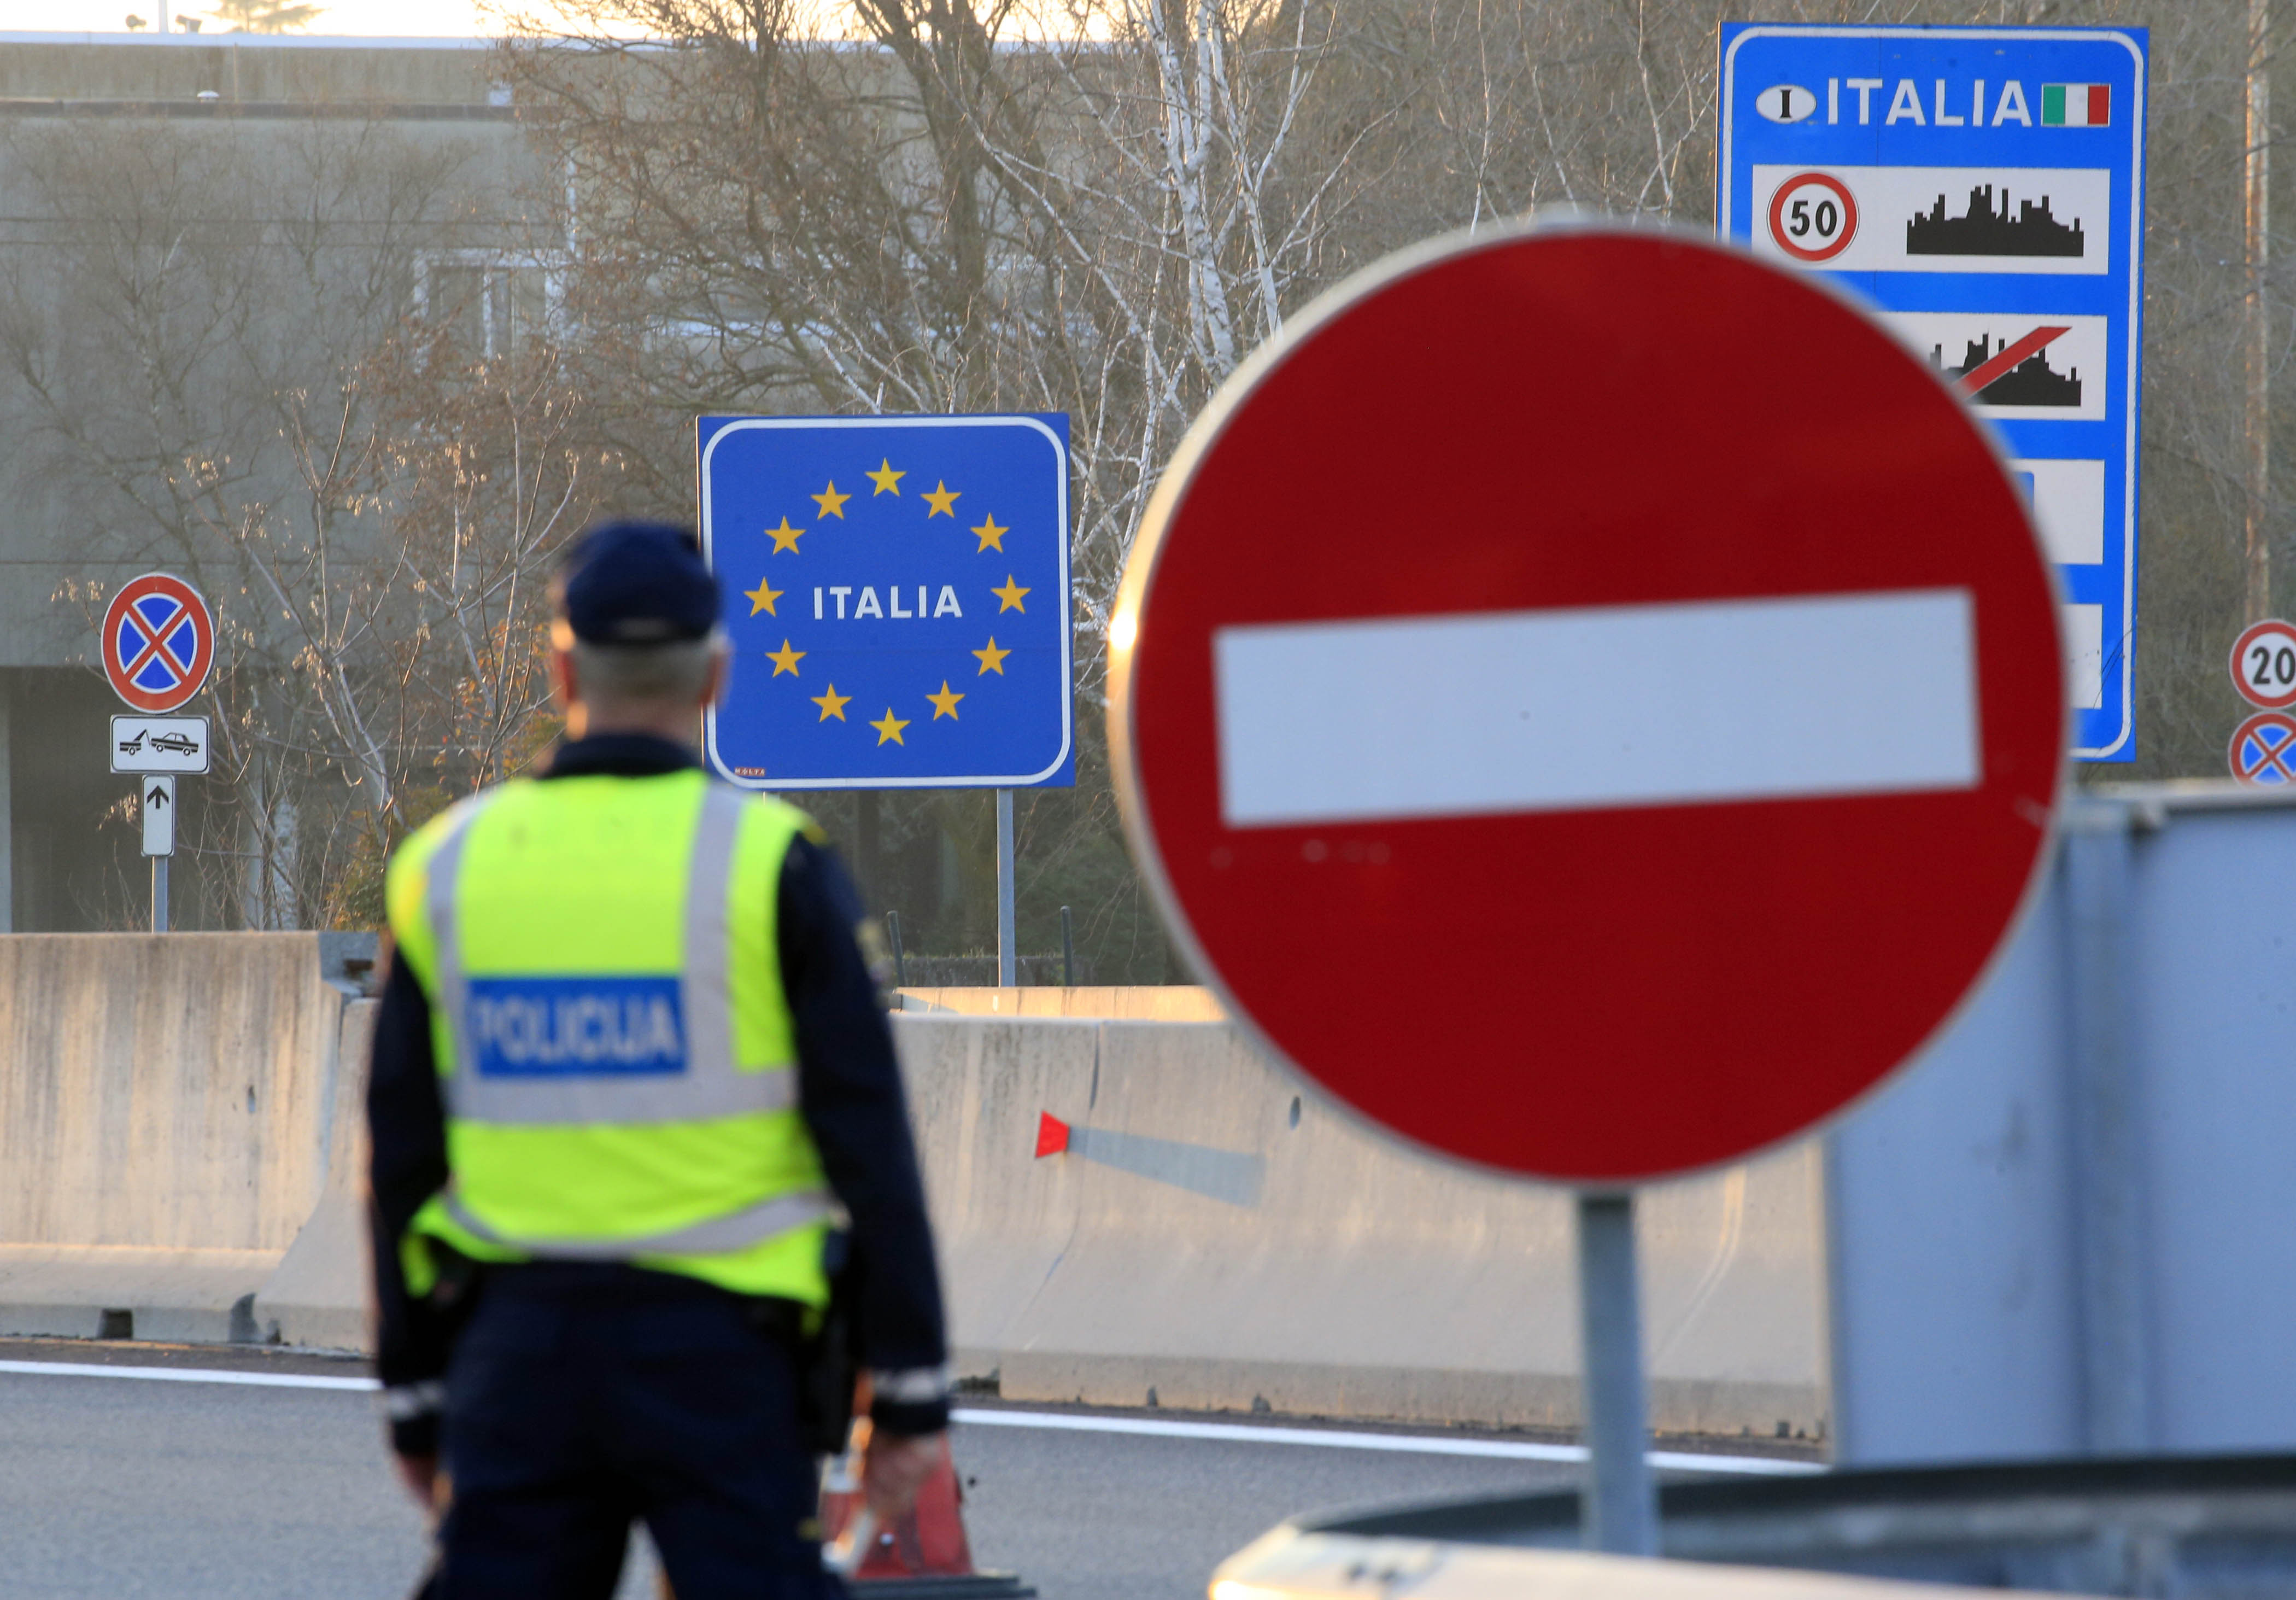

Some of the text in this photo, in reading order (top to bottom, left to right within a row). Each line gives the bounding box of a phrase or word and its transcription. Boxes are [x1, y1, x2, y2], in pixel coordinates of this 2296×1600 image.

[1779, 78, 2033, 127] I ITALIA
[1789, 200, 1837, 237] 50
[813, 585, 963, 620] ITALIA
[2251, 646, 2296, 685] 20
[475, 994, 681, 1063] POLICIJA
